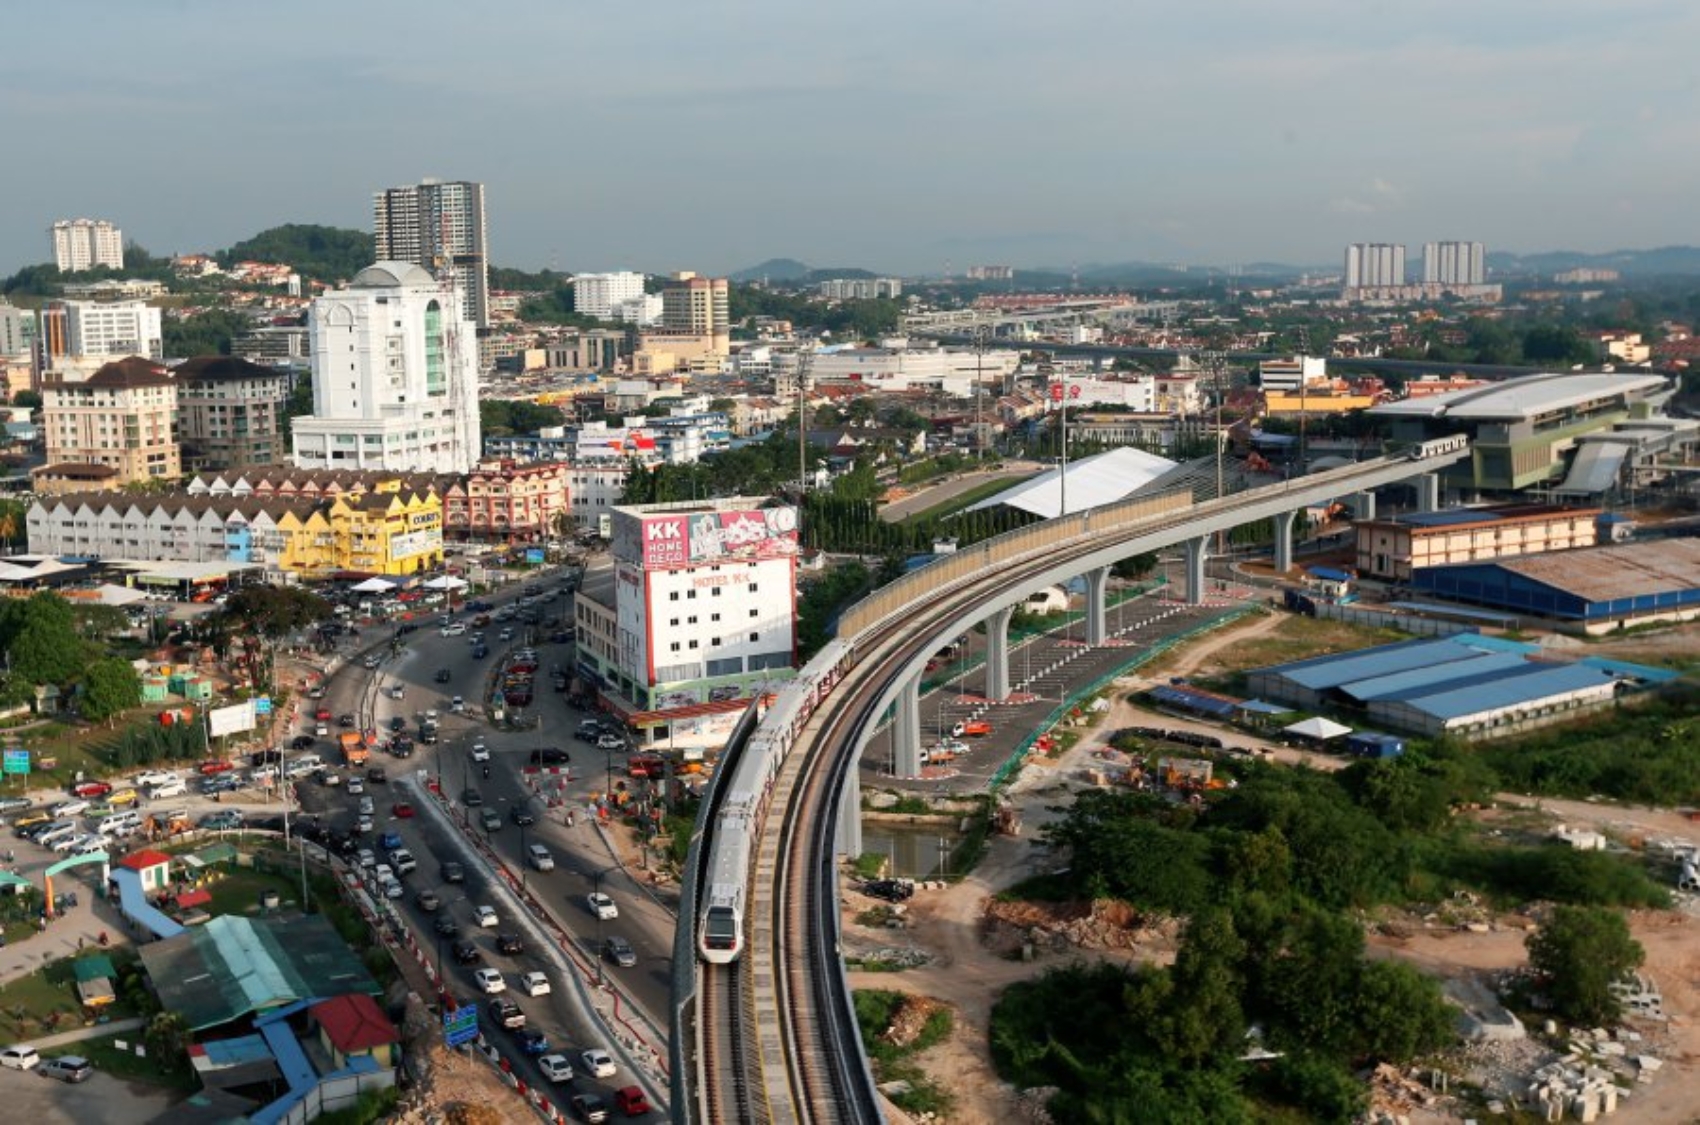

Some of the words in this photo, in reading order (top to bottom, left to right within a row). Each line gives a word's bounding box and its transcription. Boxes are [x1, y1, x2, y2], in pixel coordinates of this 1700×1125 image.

[648, 522, 681, 540] KK
[649, 541, 682, 552] HOME
[649, 552, 682, 563] DECO
[692, 575, 728, 587] HOTEL
